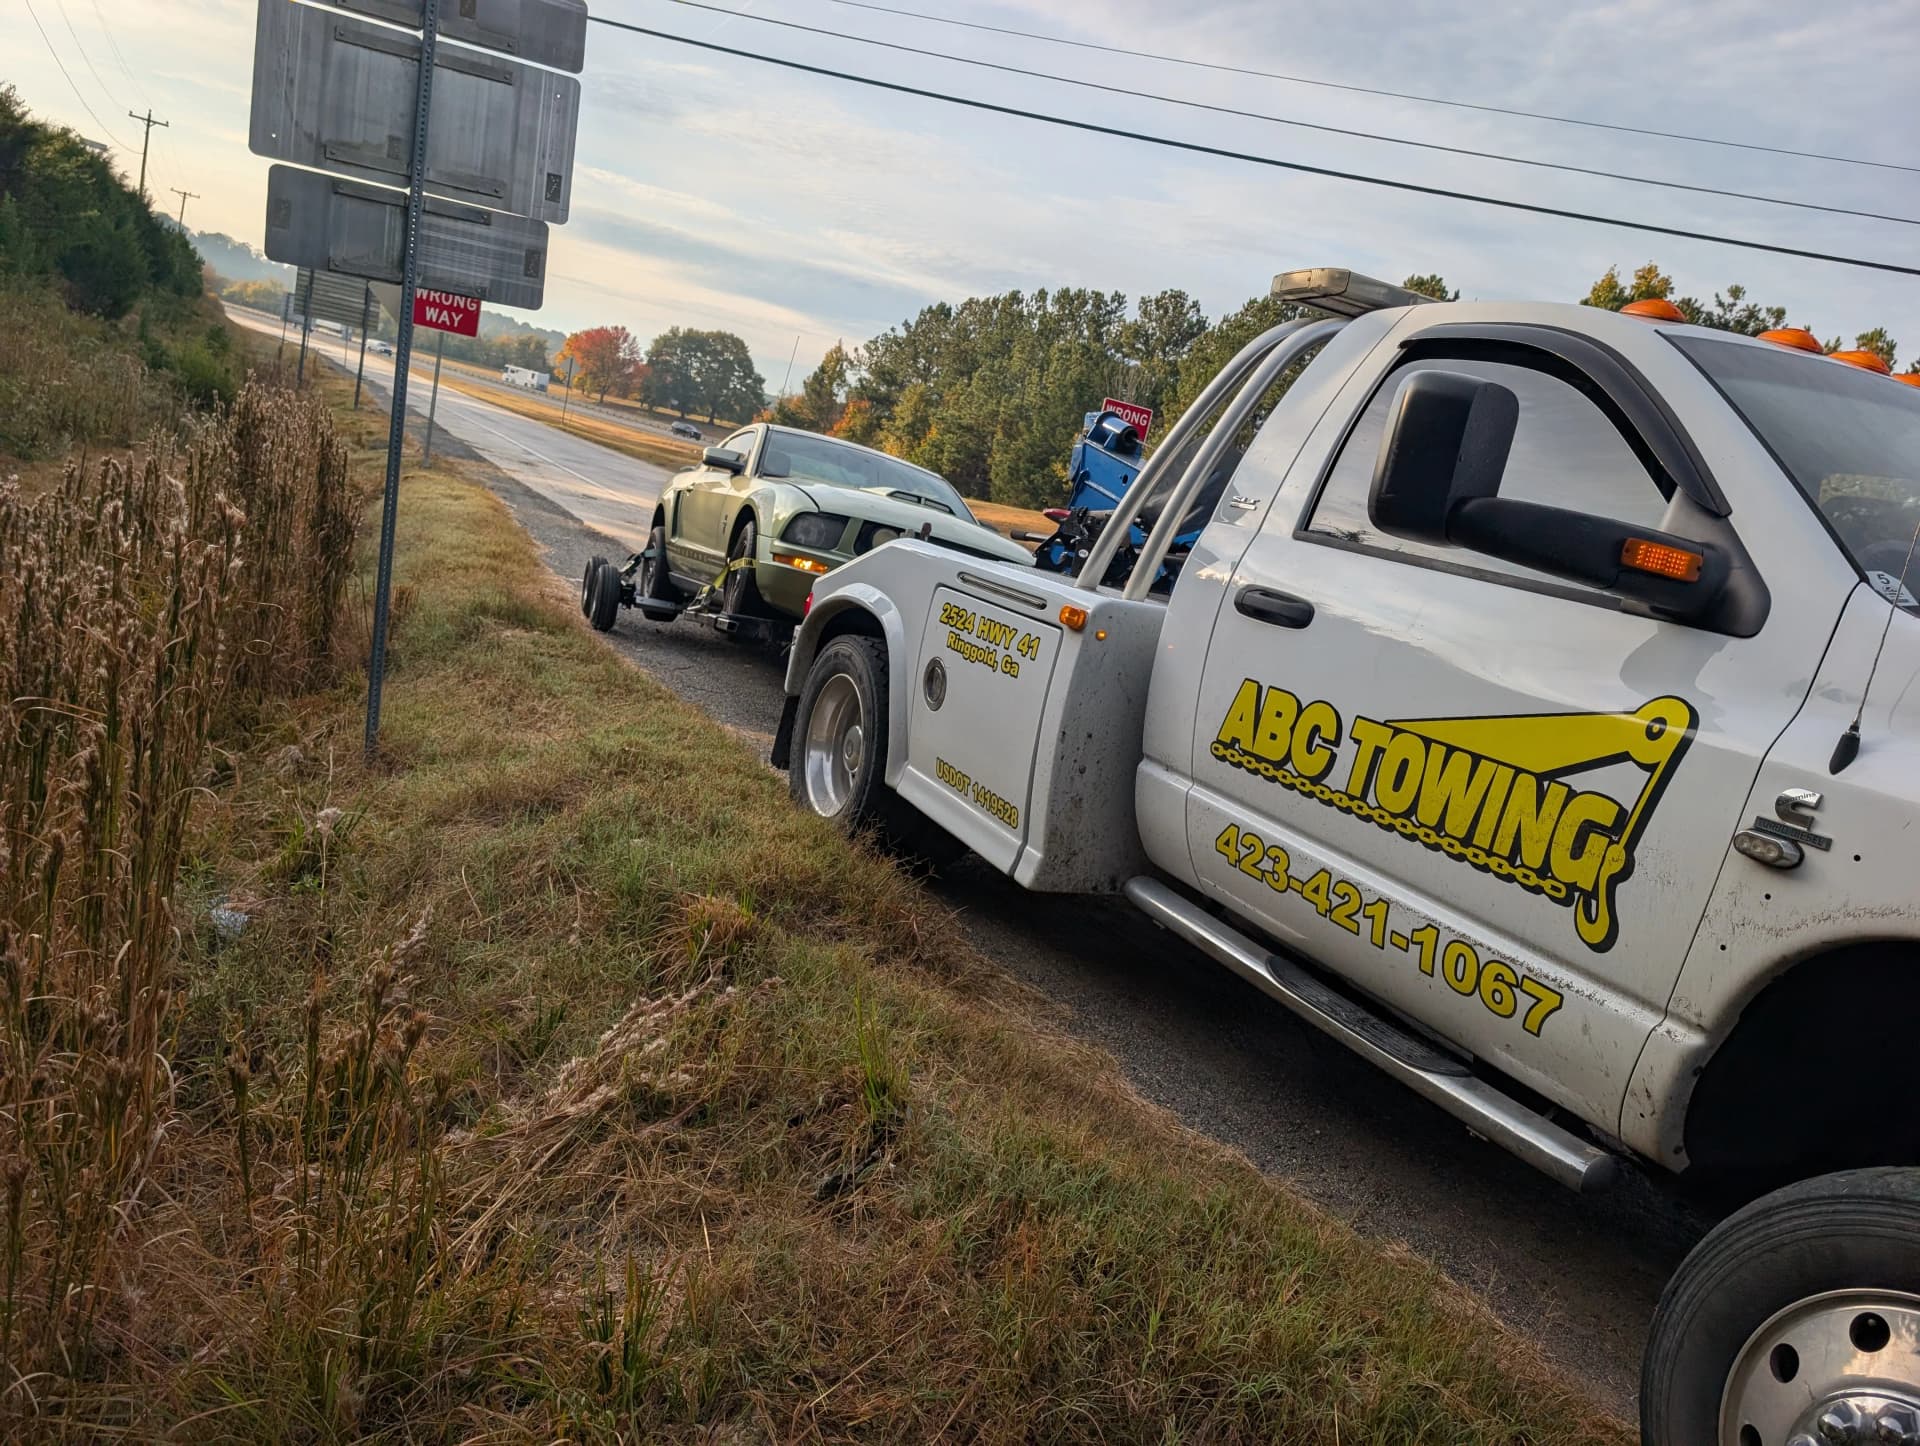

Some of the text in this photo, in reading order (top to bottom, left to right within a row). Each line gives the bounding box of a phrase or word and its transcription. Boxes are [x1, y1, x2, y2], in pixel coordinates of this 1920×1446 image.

[416, 288, 477, 311] WRONG
[426, 306, 463, 327] WAY
[939, 602, 1041, 661] 2524 HWY 41
[946, 631, 1020, 678] Ringgold, Ga
[935, 756, 1019, 829] USDOT 1419528
[1216, 677, 1628, 894] ABC TOWING
[1215, 823, 1564, 1036] 423-421-1067
